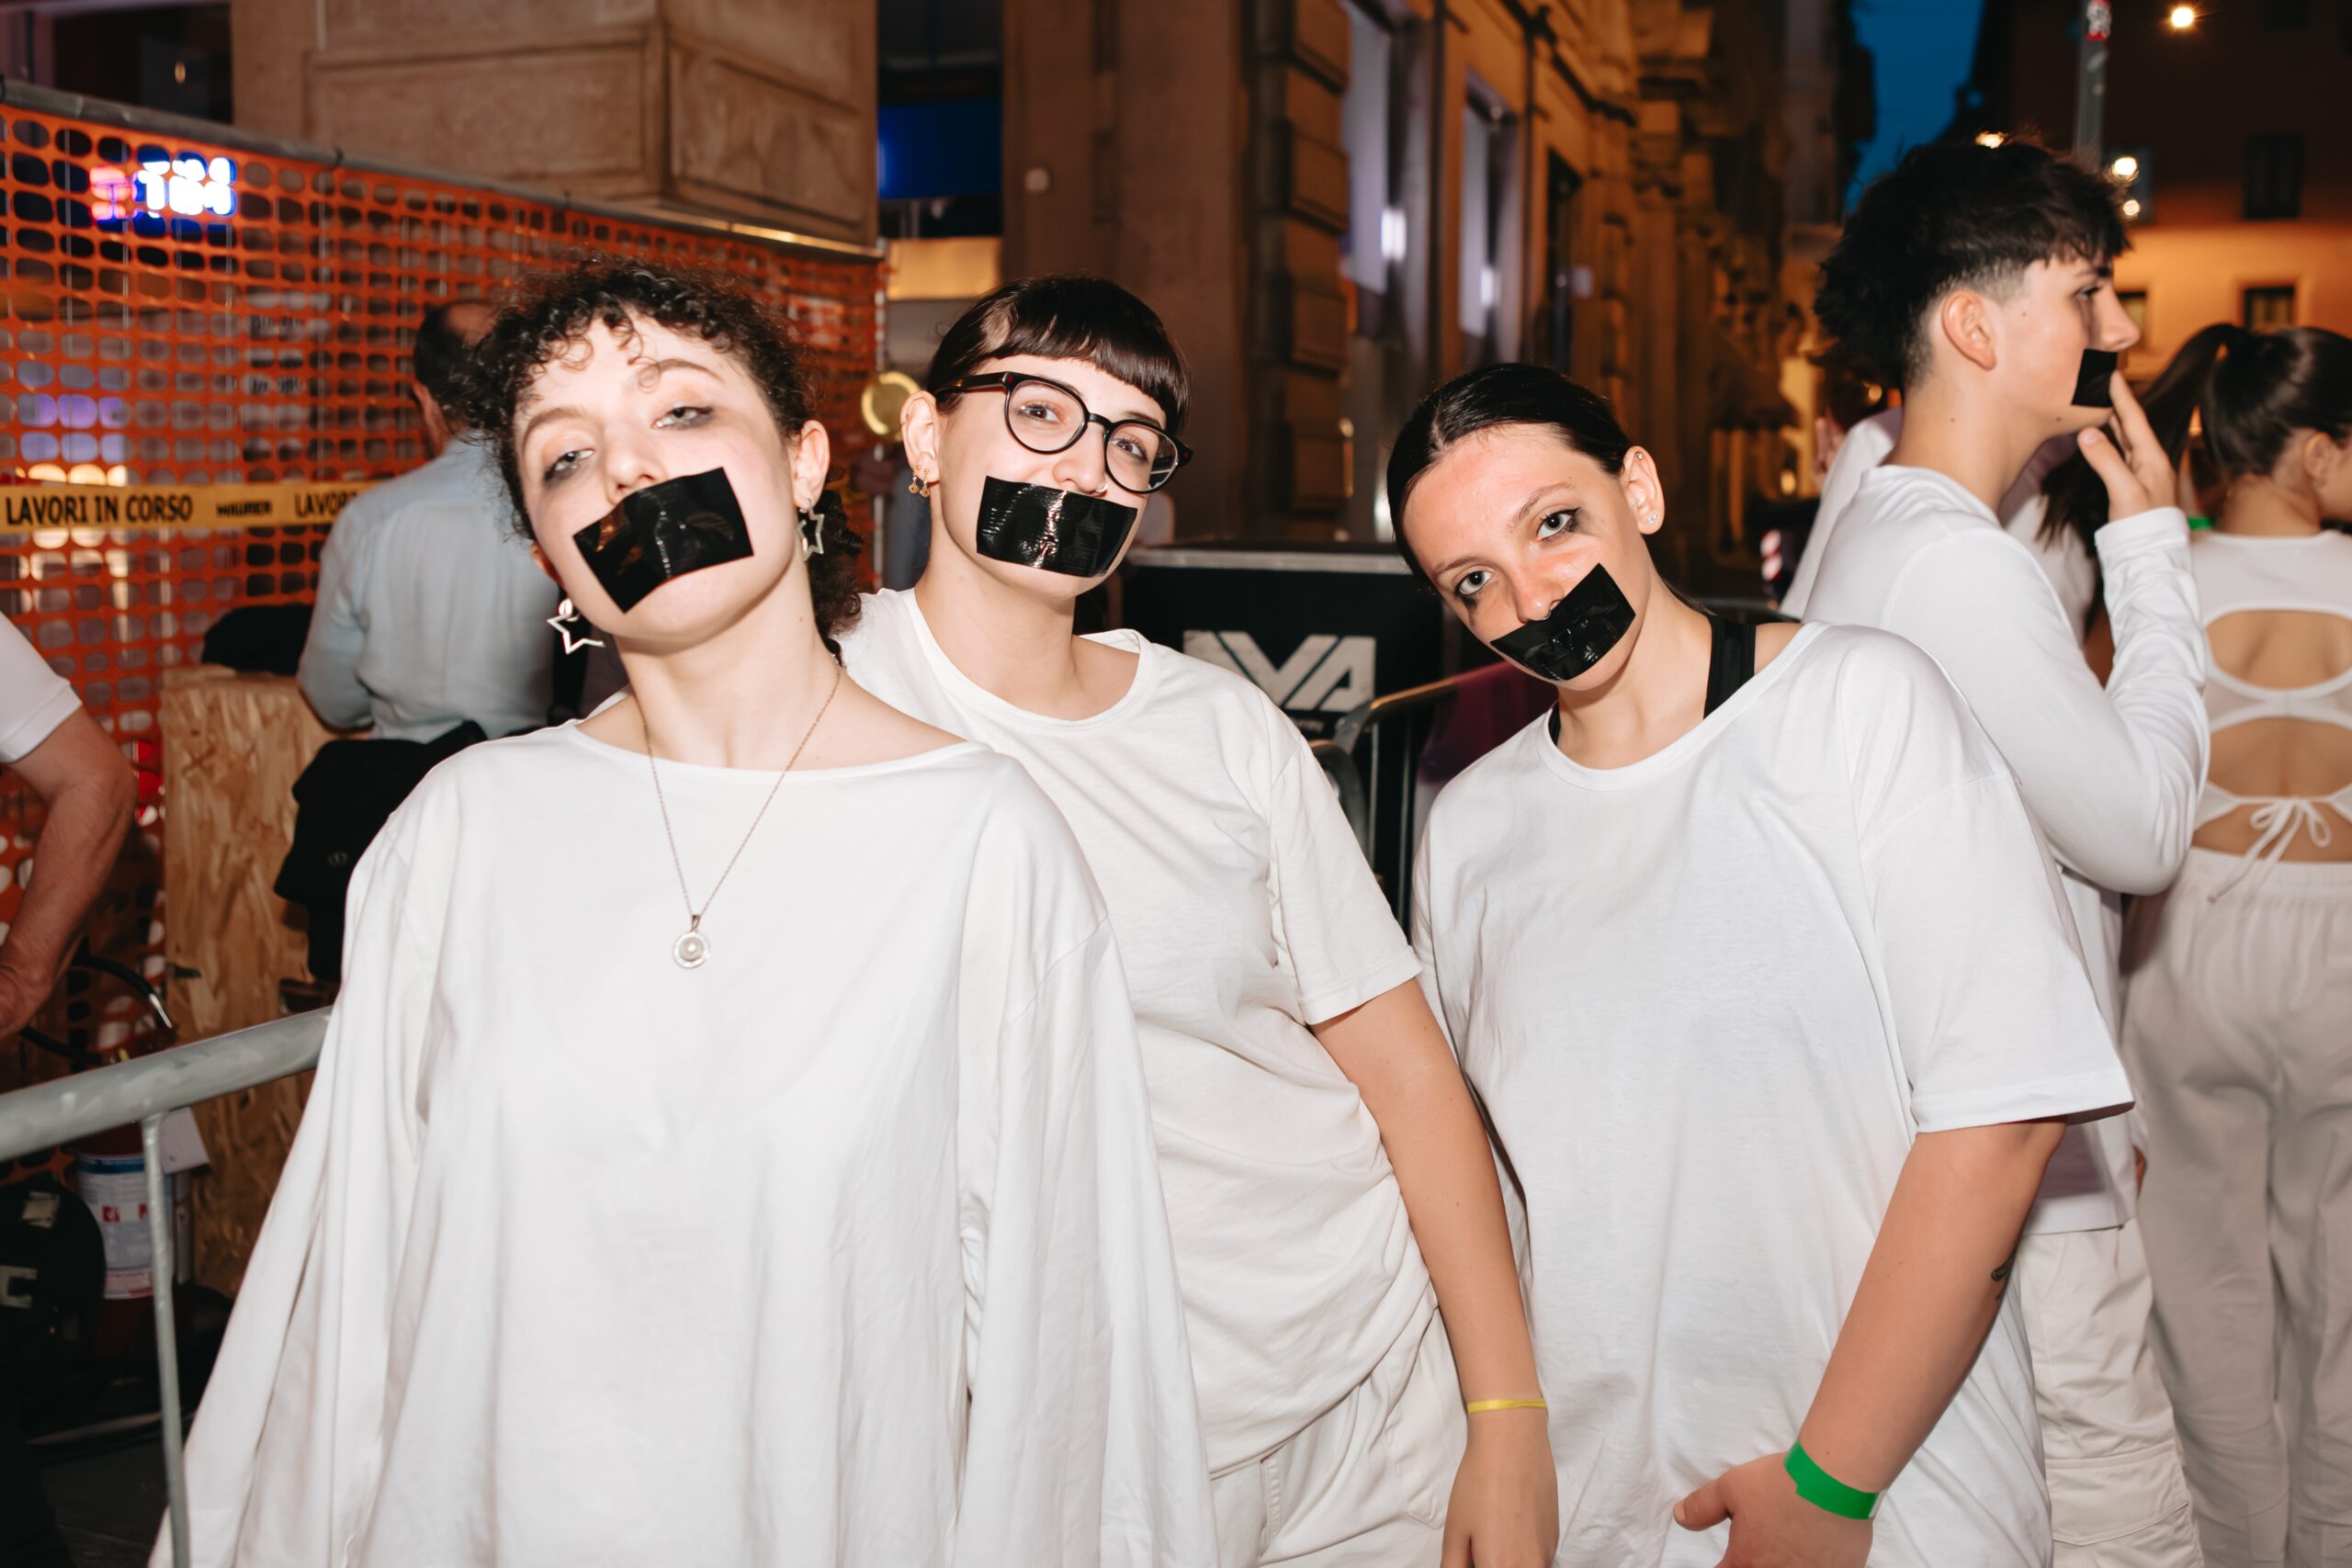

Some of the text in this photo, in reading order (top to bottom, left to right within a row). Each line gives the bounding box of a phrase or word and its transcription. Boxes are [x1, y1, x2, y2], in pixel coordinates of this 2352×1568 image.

[6, 493, 194, 525] LAVORI IN CORSO
[294, 490, 357, 517] LAVOR
